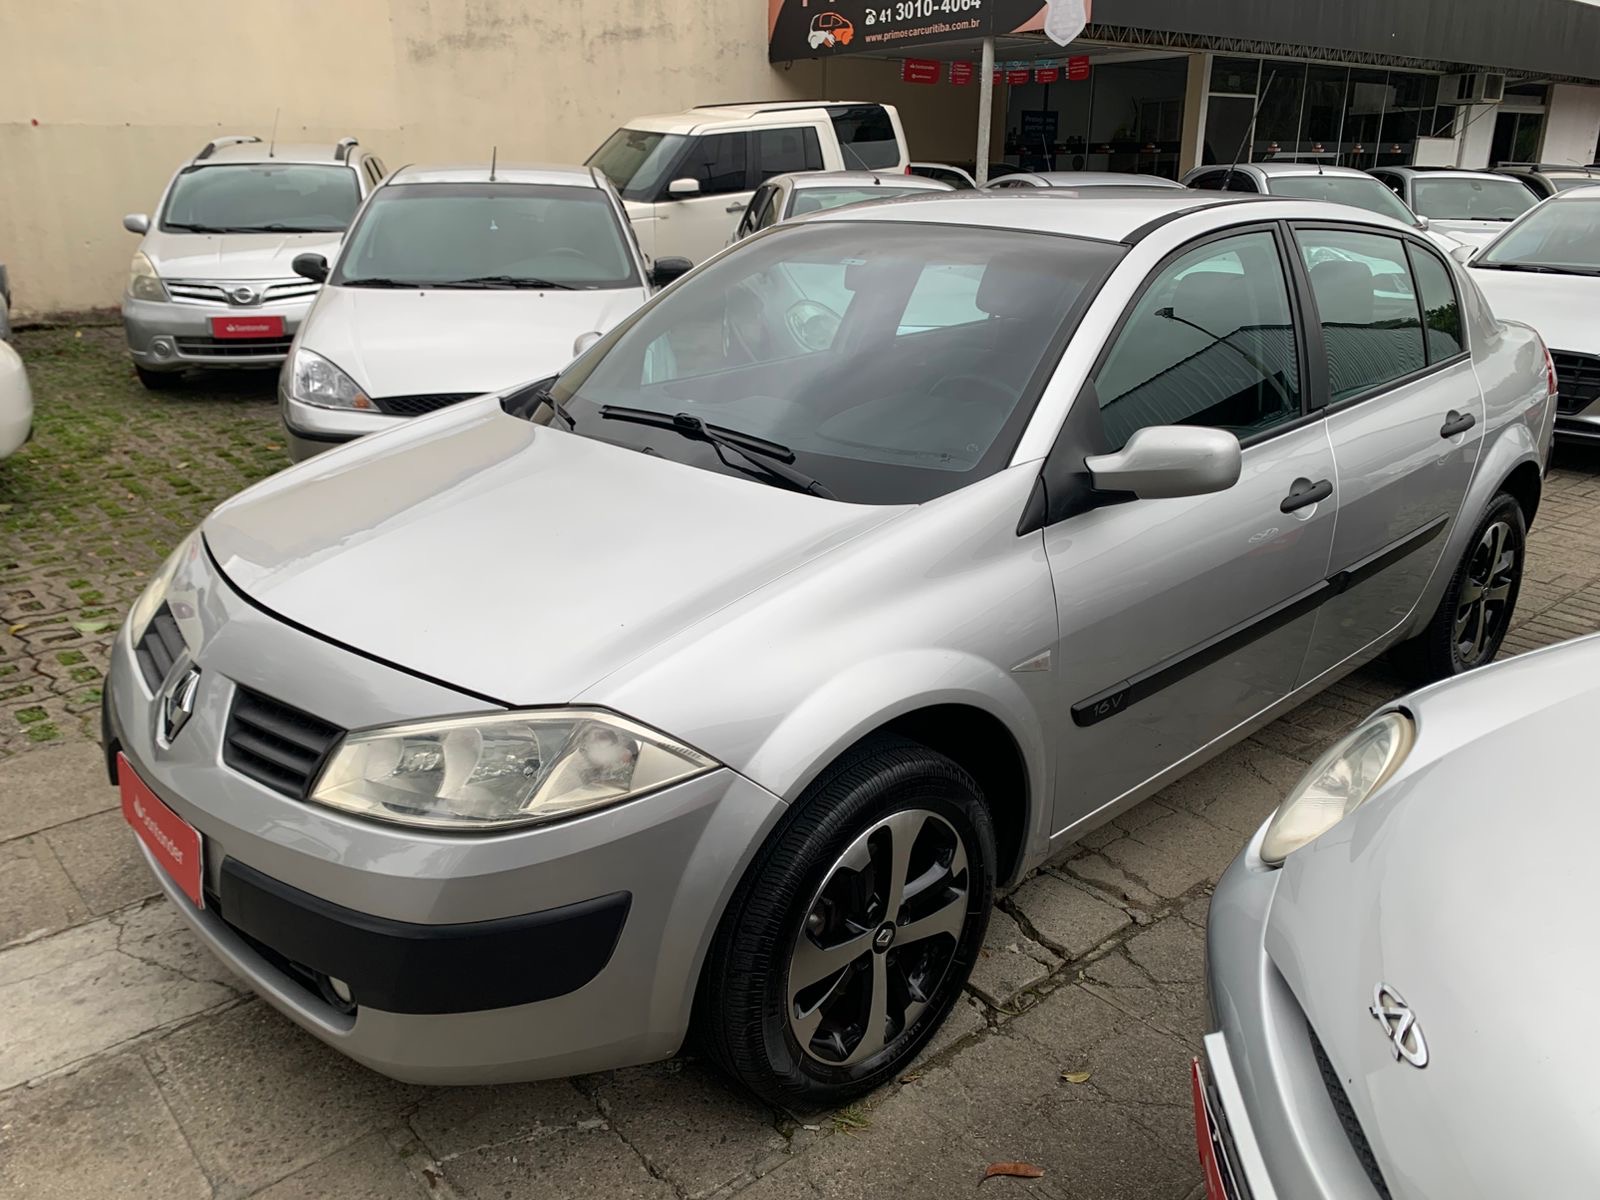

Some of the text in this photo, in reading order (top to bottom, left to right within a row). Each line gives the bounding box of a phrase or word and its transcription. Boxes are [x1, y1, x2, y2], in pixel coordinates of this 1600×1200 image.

[879, 8, 892, 23] 41
[864, 18, 980, 42] www.primoscarcuritiba.com.br
[1095, 693, 1123, 716] 16V
